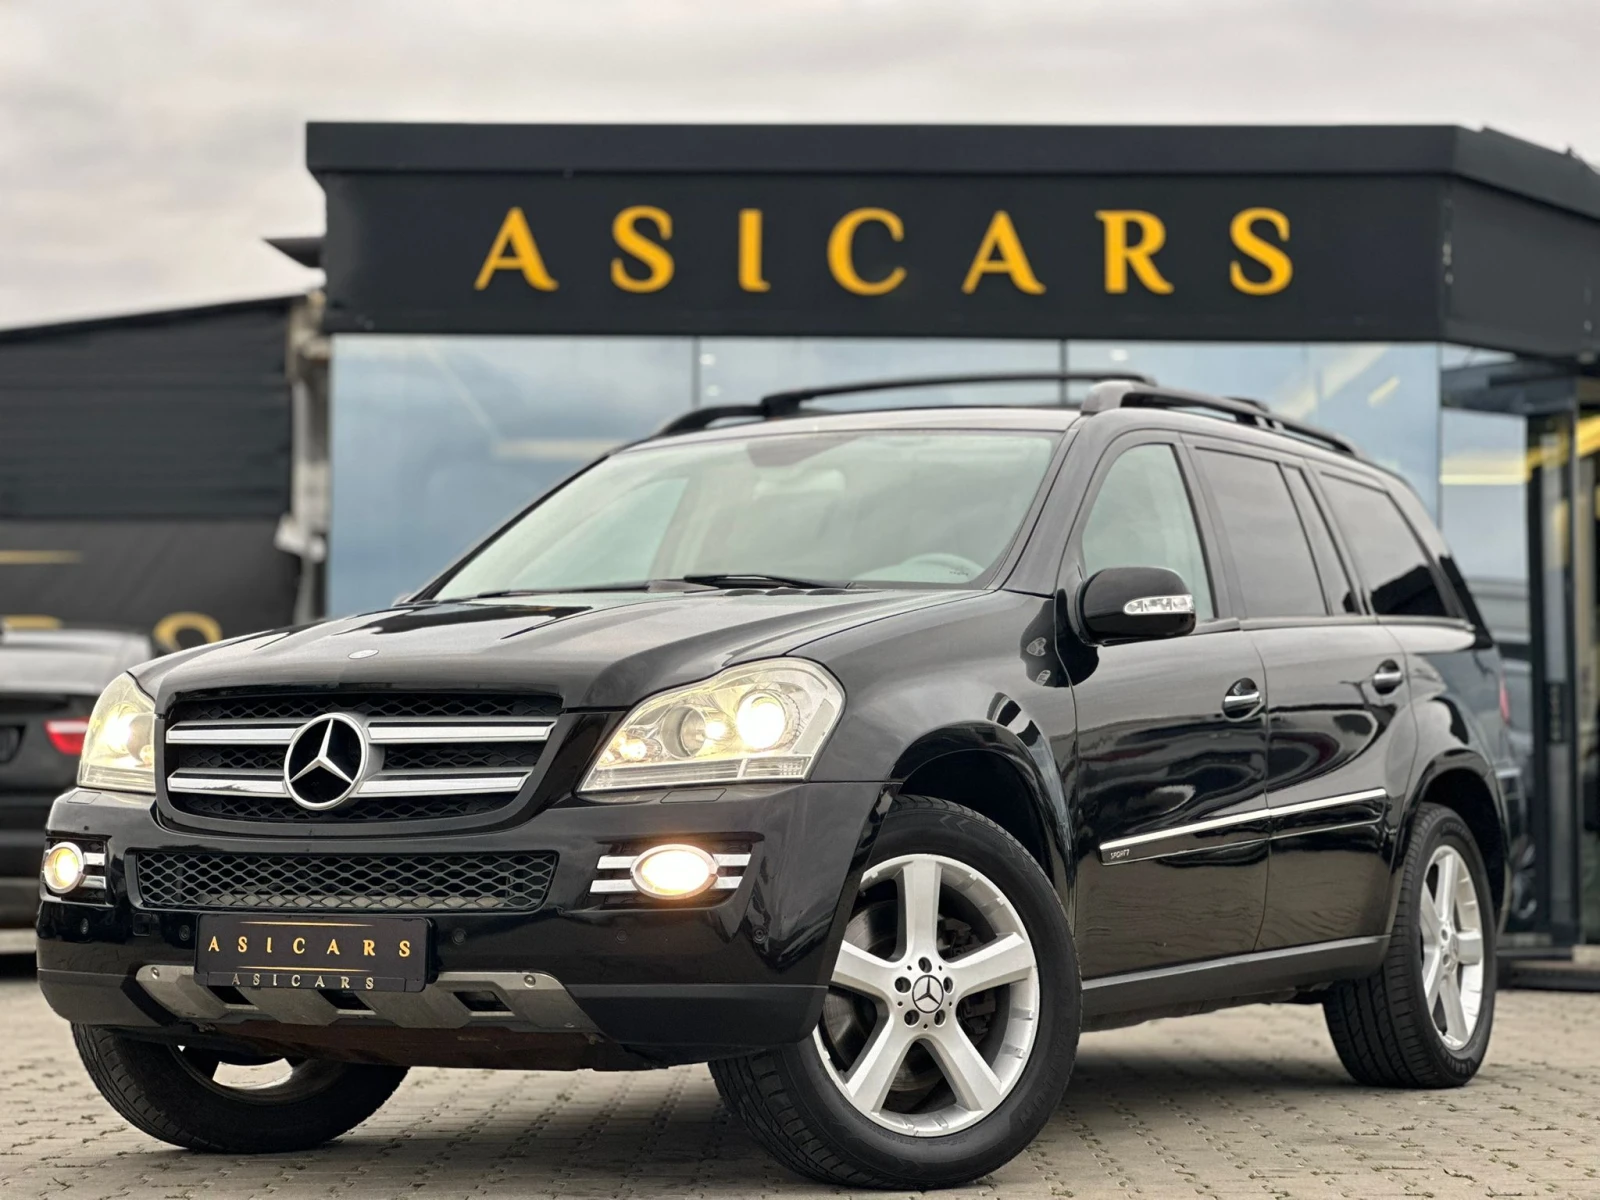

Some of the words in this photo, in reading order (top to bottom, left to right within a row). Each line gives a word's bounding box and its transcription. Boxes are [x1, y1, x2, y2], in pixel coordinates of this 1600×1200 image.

[475, 206, 1294, 295] ASICARS
[208, 935, 411, 958] ASICARS
[232, 972, 374, 990] ASICARS
